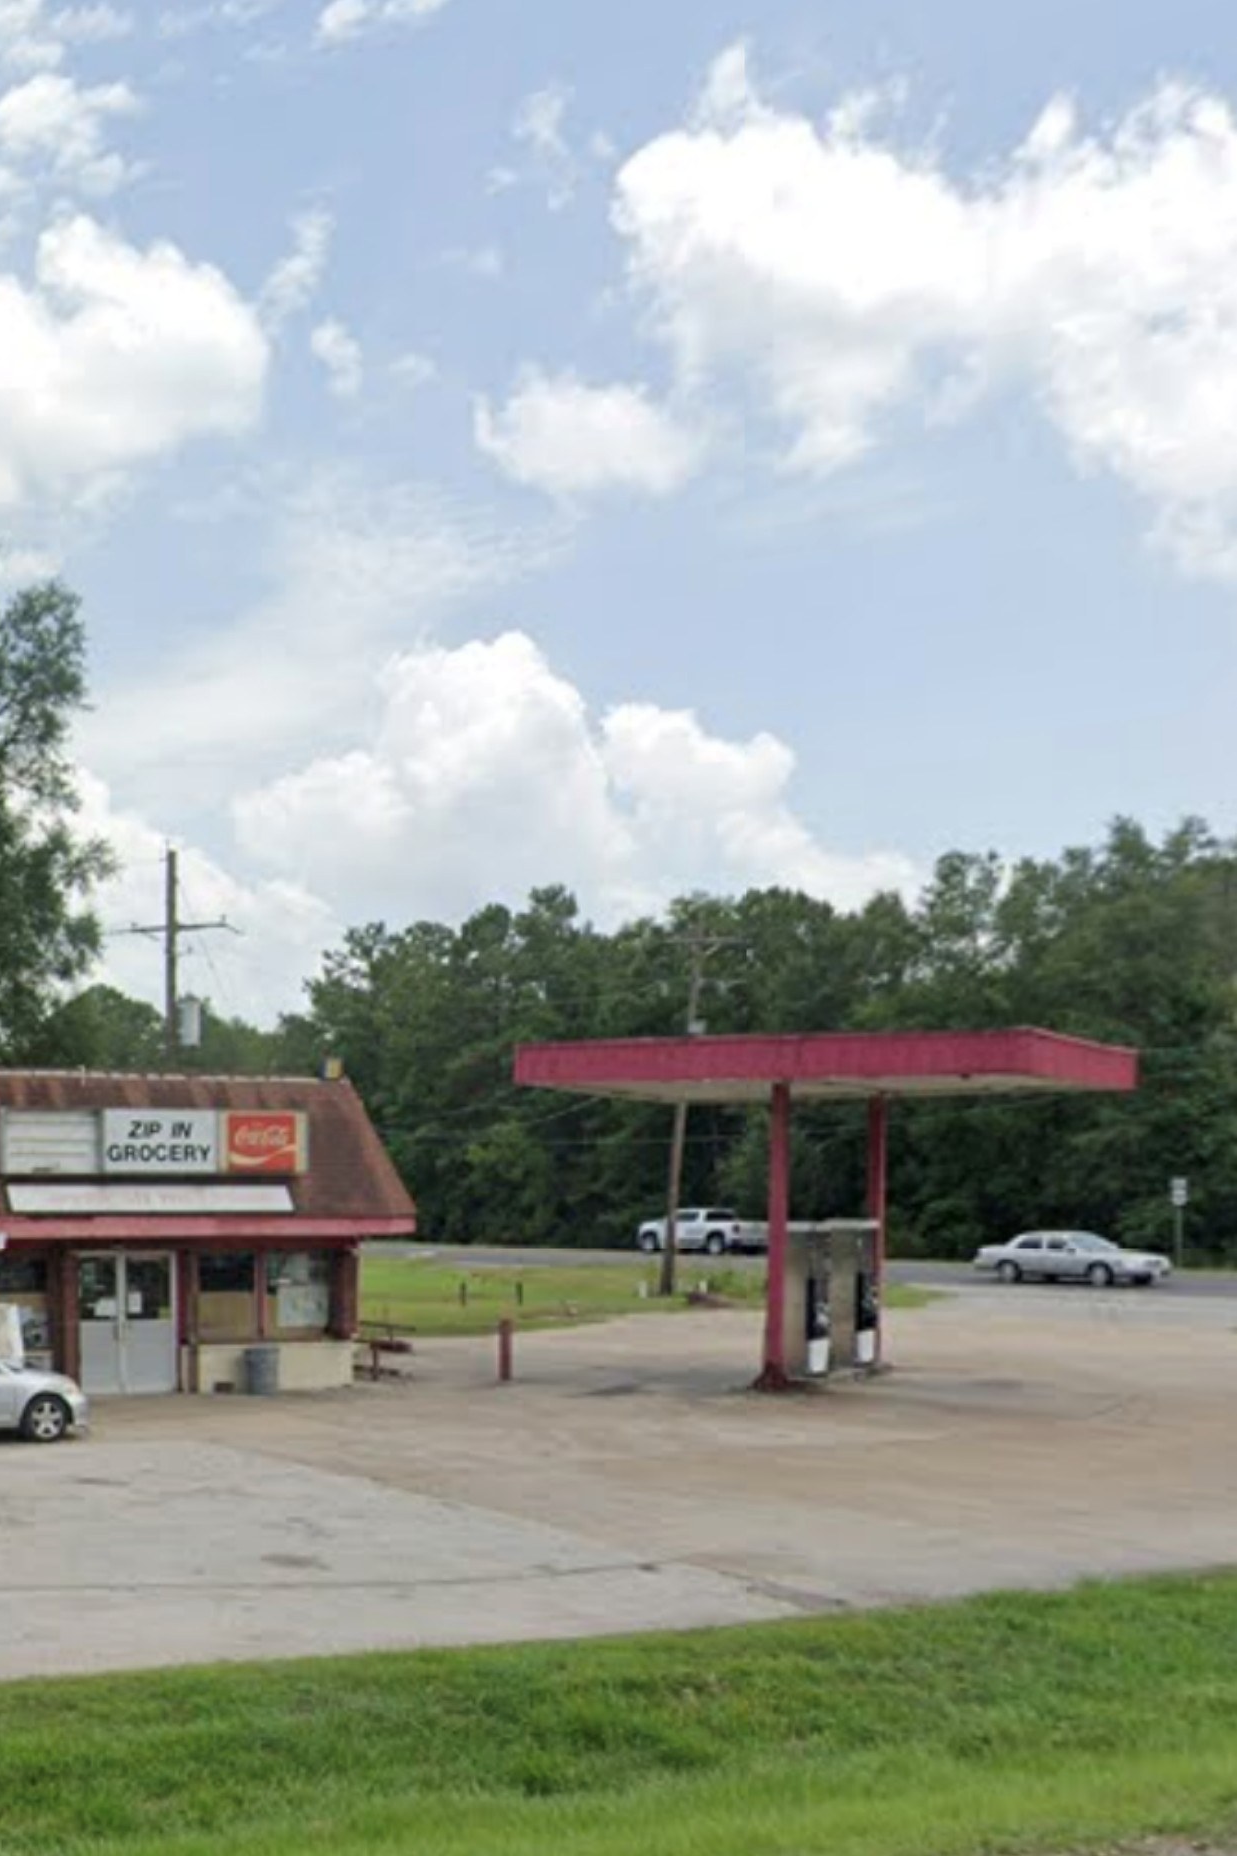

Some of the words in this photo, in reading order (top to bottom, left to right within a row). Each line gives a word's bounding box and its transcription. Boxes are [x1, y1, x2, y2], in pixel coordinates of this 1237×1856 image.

[128, 1120, 162, 1138] ZIP
[170, 1121, 193, 1138] IN
[107, 1144, 211, 1162] GROCERY
